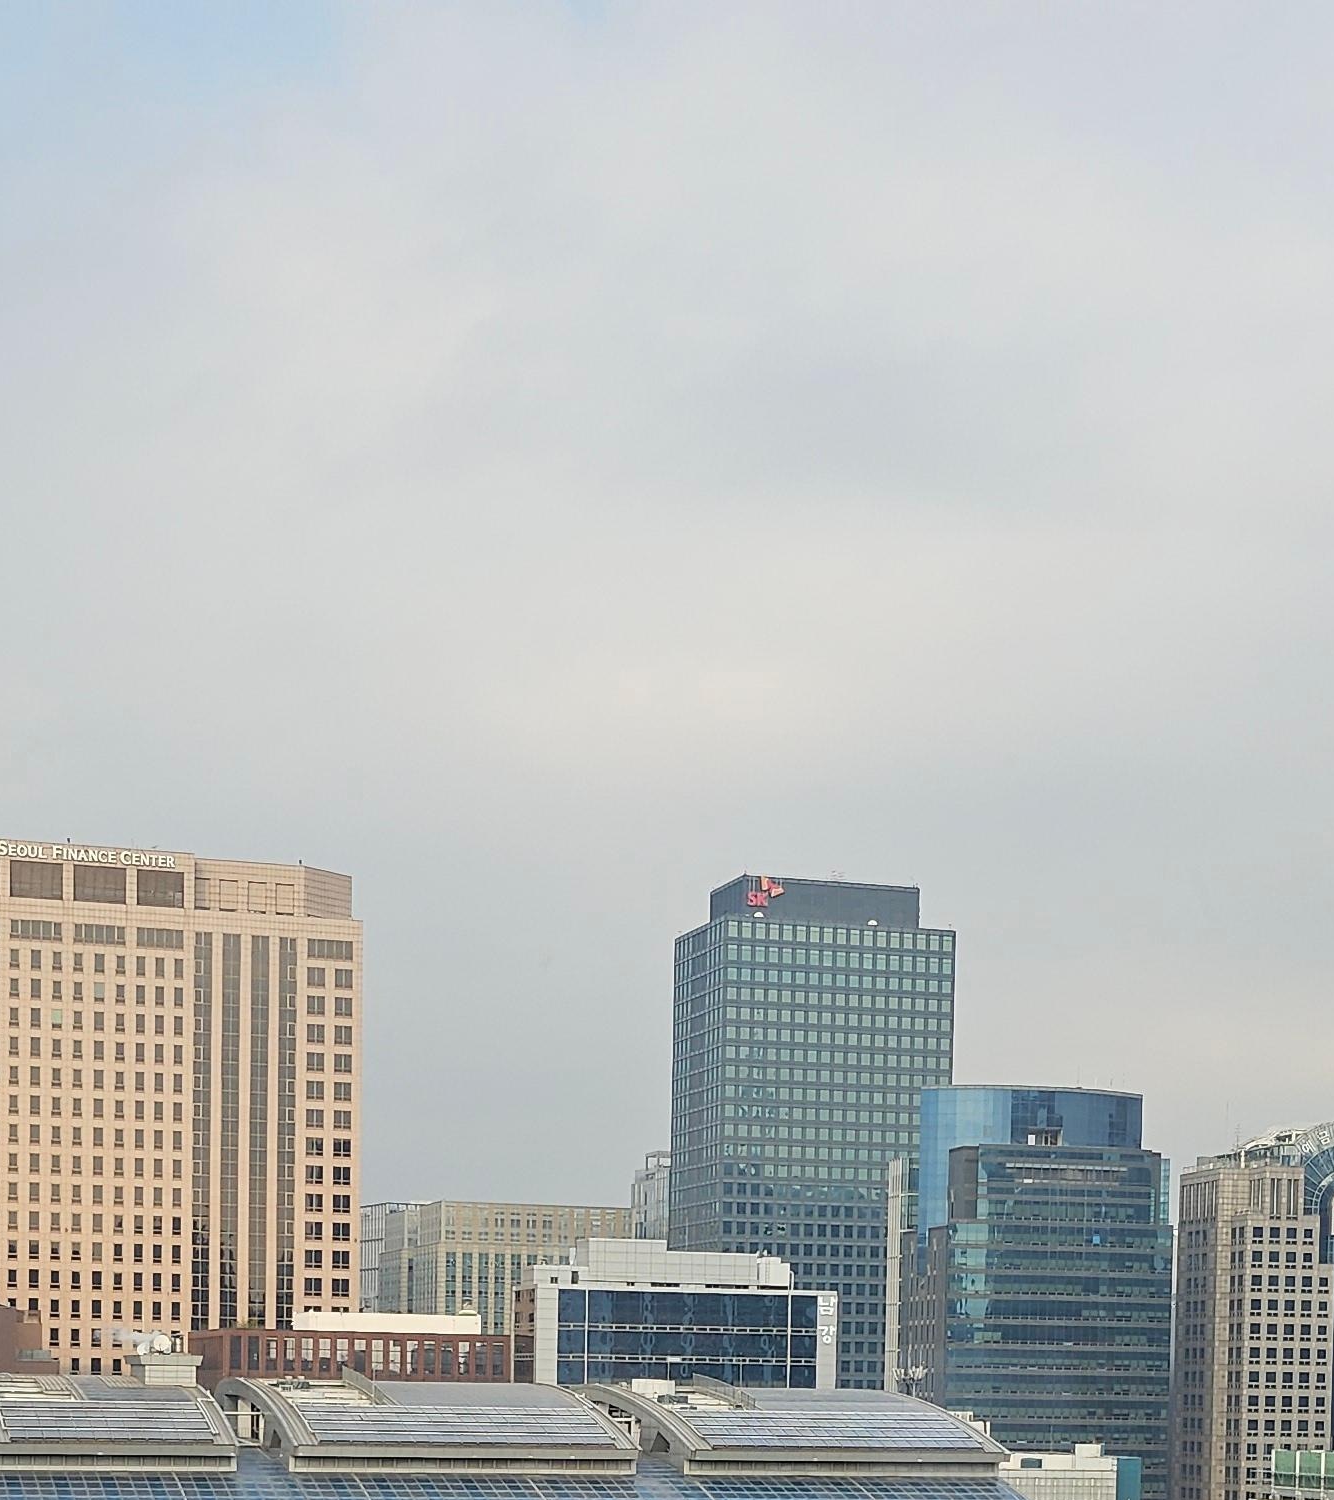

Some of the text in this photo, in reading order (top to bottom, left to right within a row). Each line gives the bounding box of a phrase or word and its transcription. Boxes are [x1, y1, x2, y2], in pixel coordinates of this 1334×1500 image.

[52, 845, 118, 864] FINANCE
[120, 850, 176, 869] CENTER
[747, 891, 769, 907] SK
[818, 1295, 836, 1345] 남강
